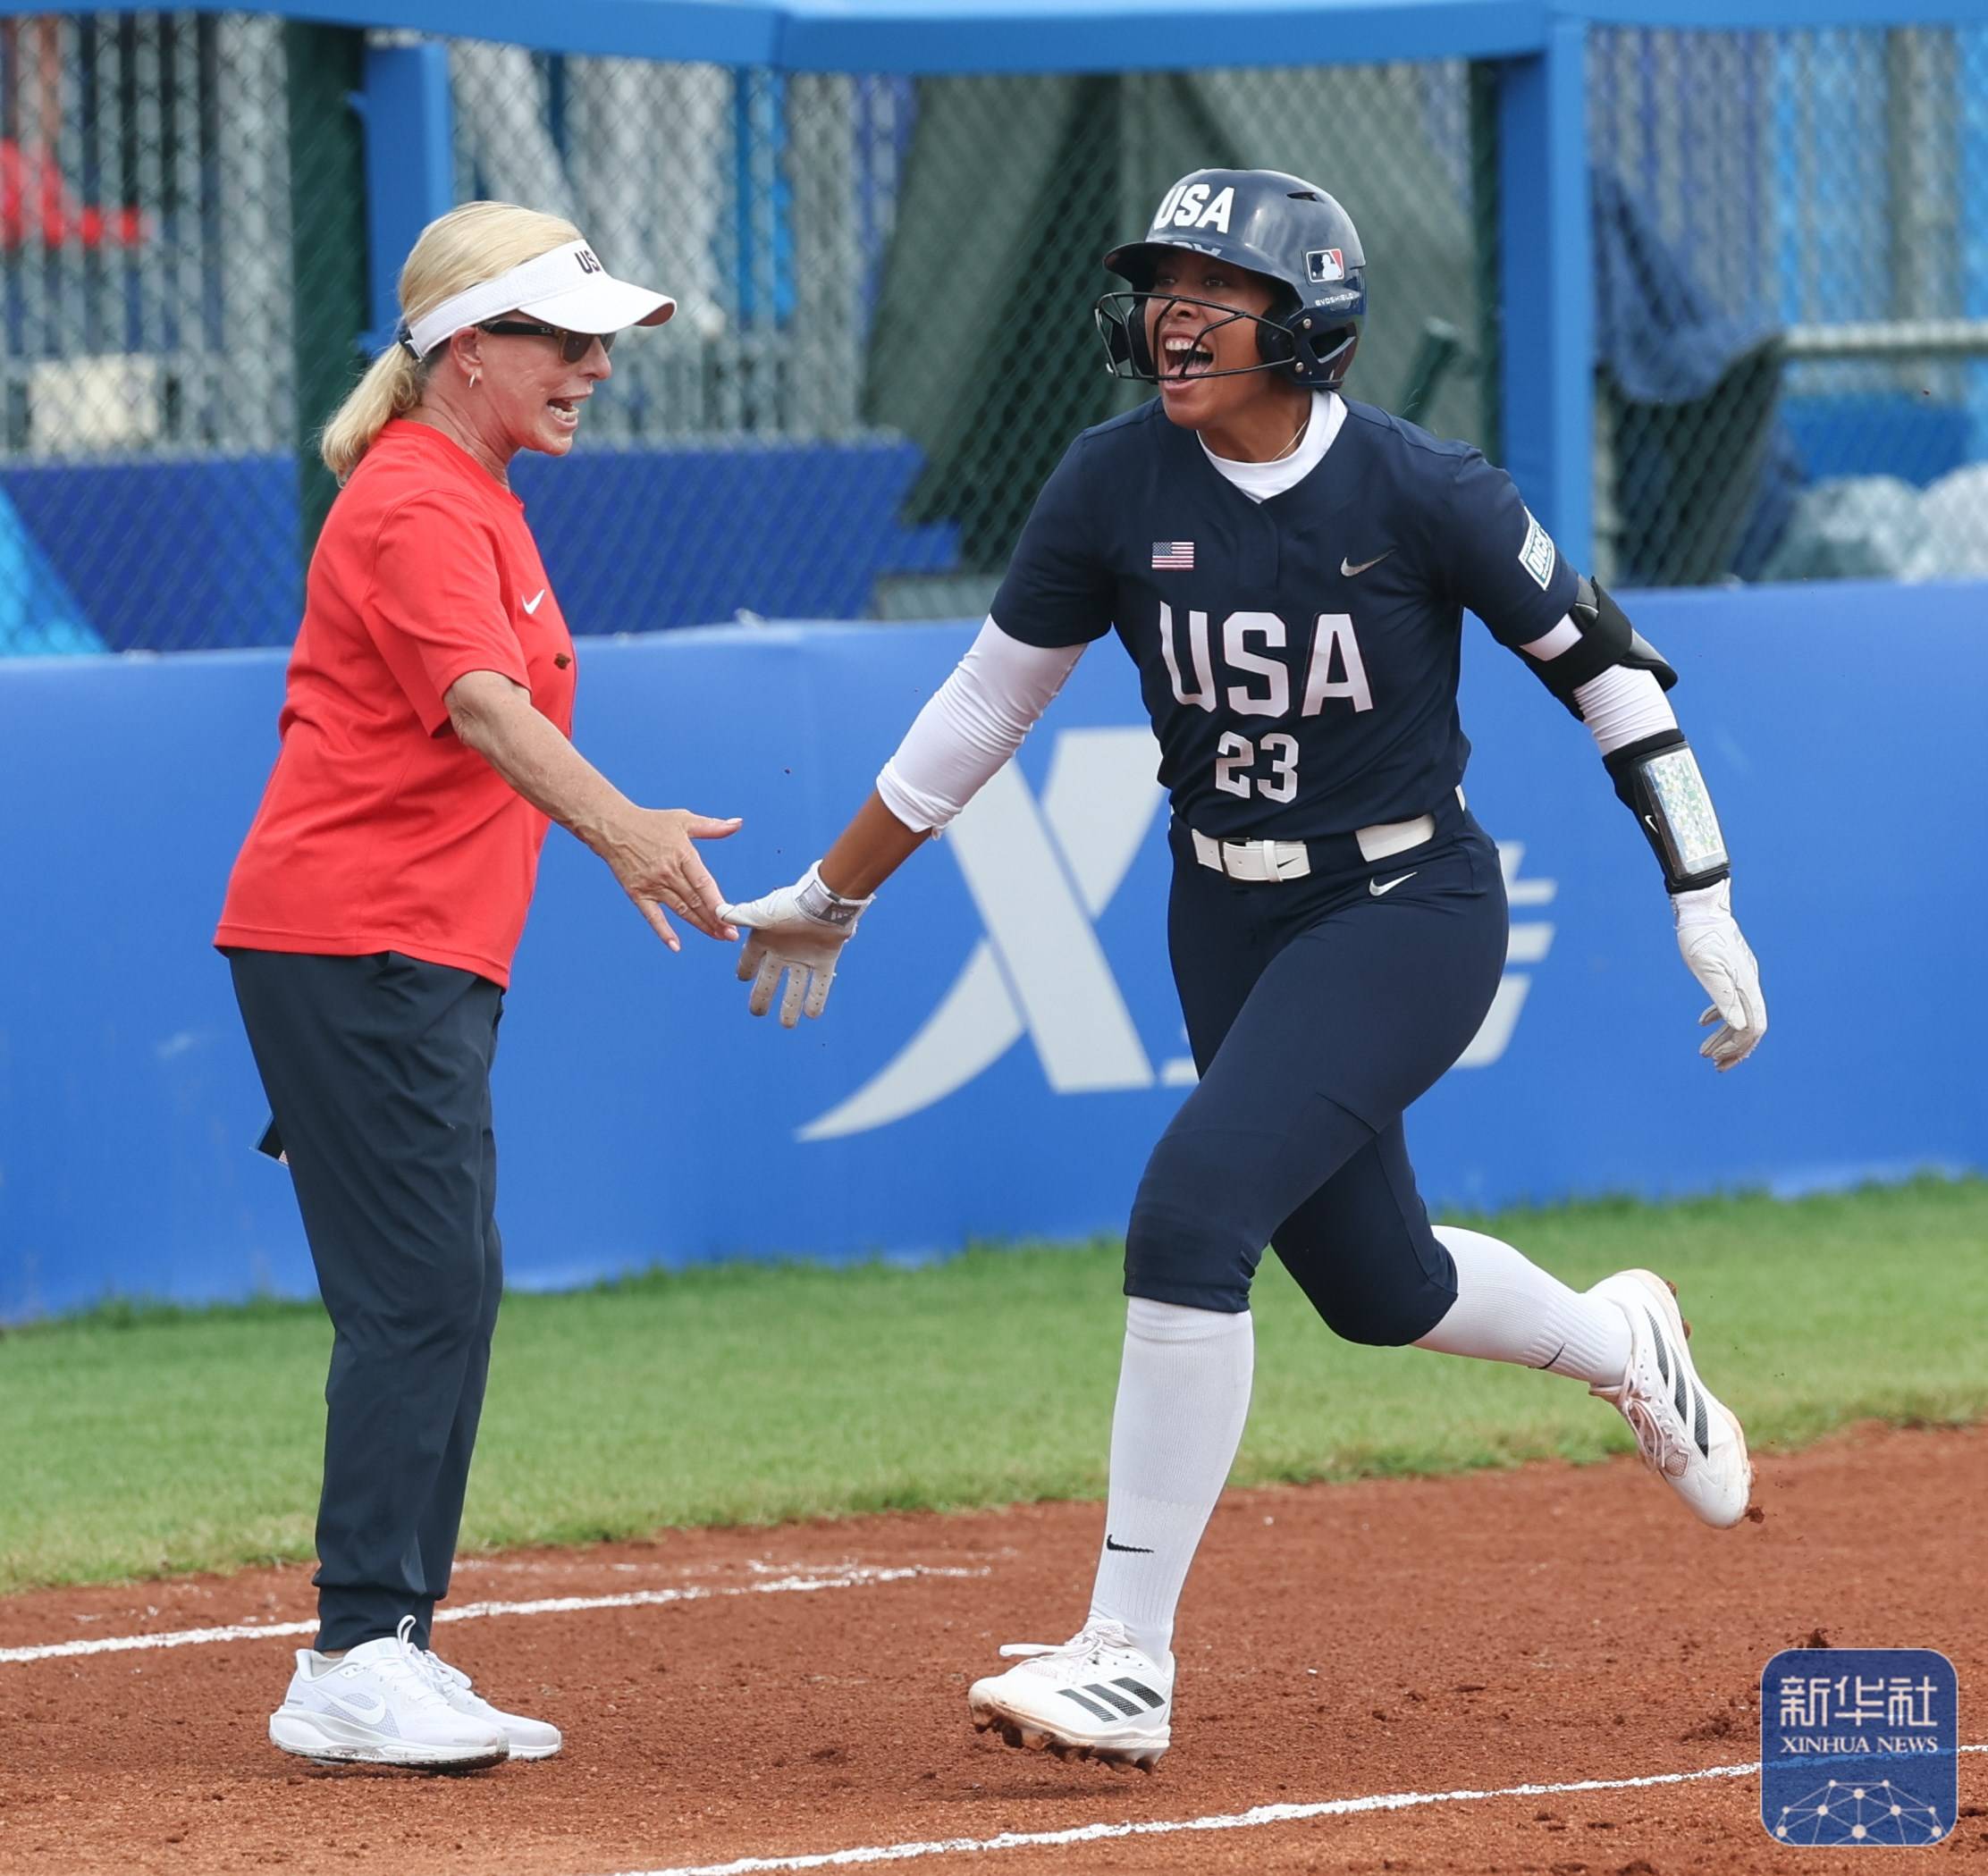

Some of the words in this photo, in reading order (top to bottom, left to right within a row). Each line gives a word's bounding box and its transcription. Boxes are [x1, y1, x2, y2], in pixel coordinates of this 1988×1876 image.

[1153, 184, 1234, 234] USA
[1159, 601, 1374, 719] USA
[1216, 730, 1299, 803] 23
